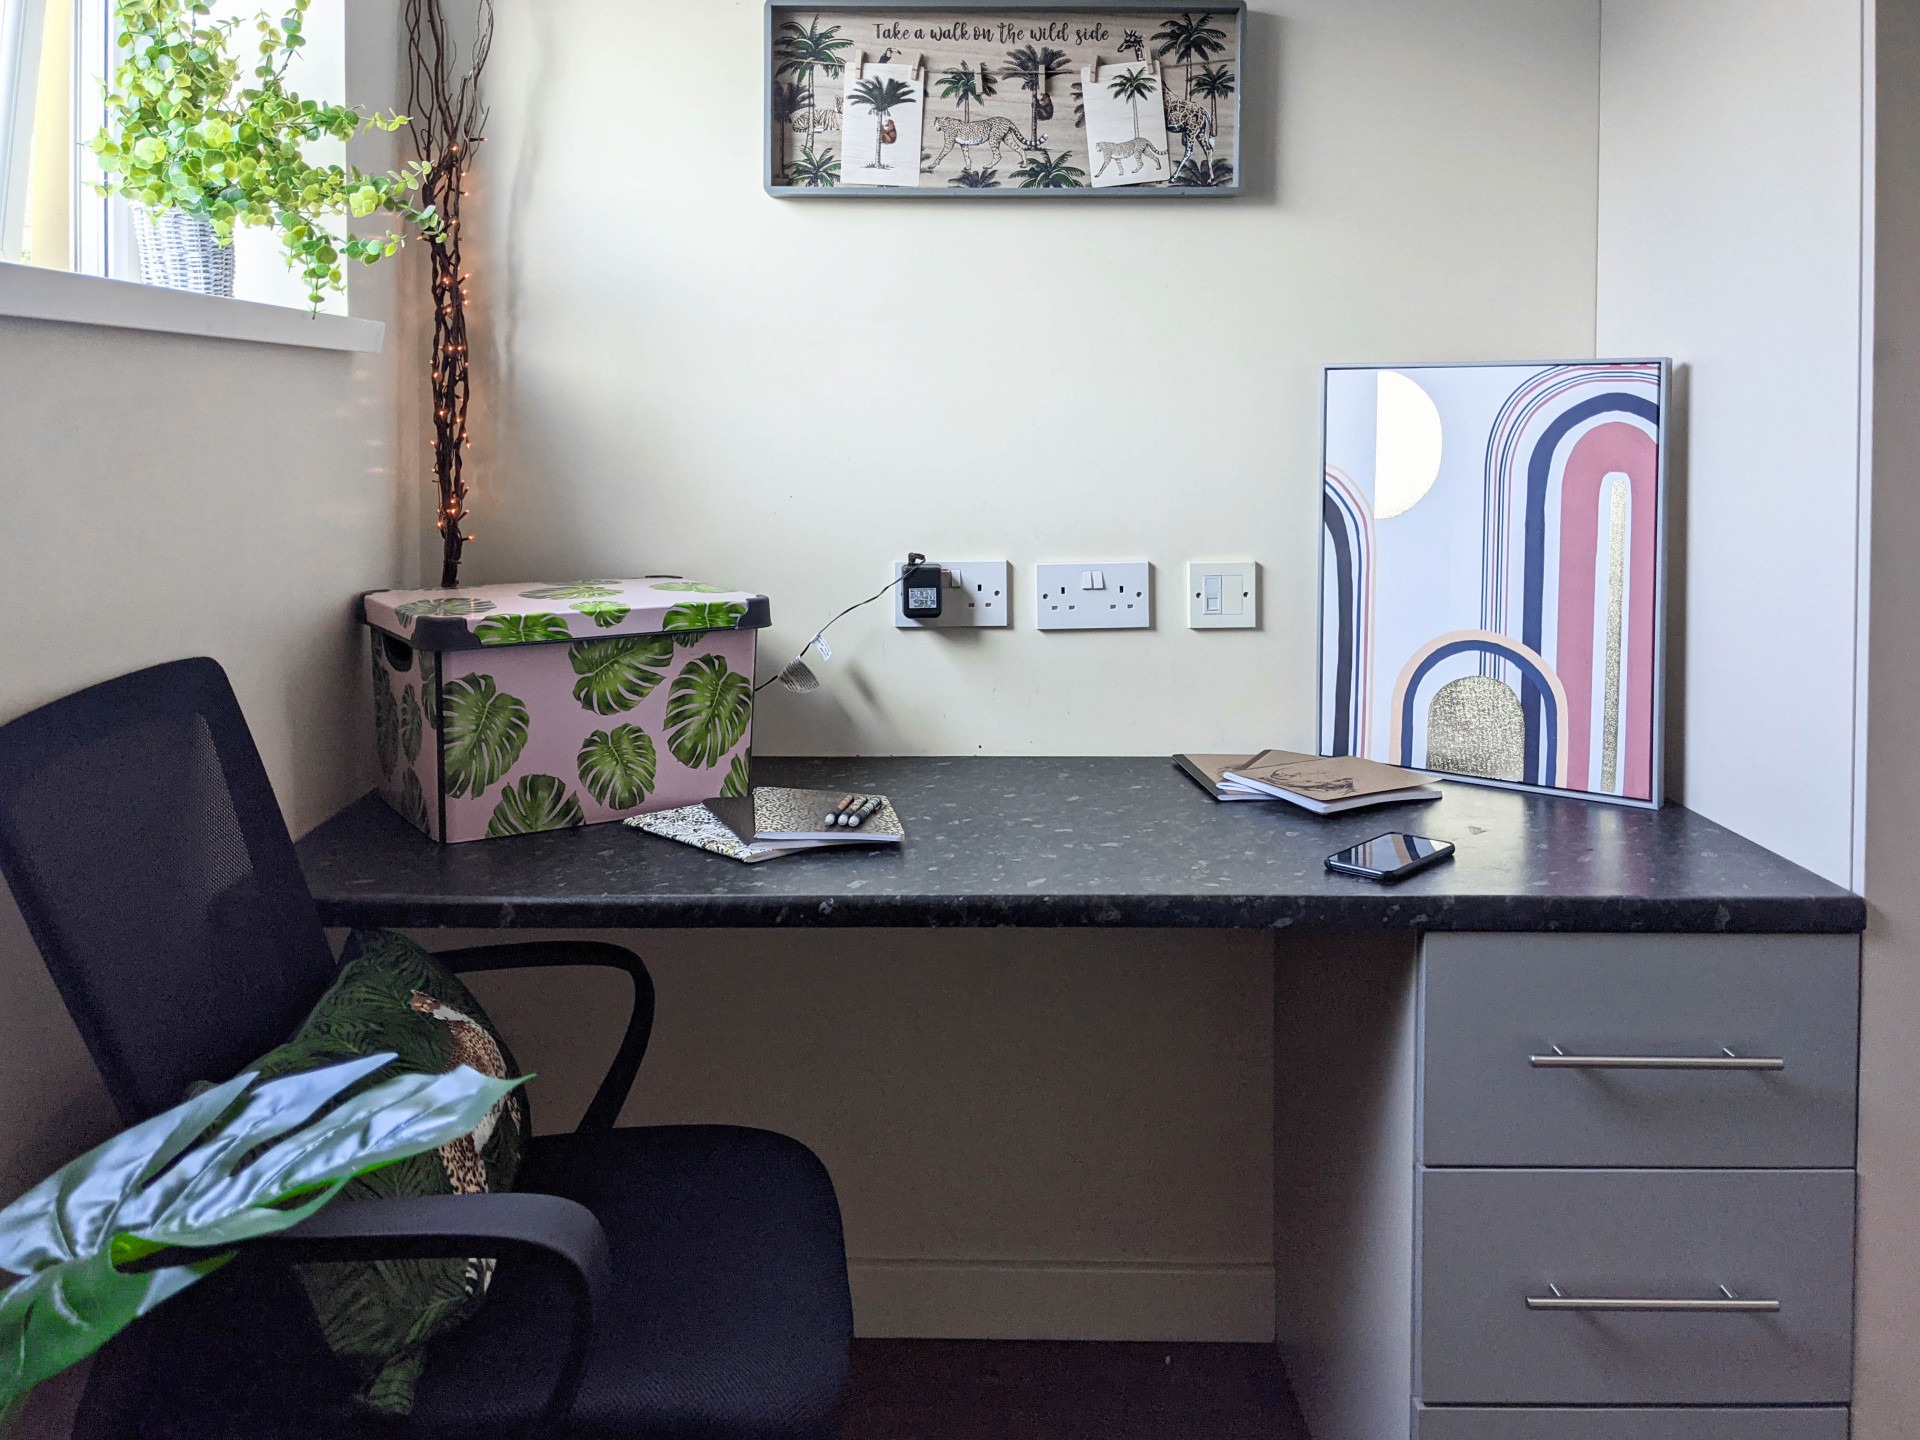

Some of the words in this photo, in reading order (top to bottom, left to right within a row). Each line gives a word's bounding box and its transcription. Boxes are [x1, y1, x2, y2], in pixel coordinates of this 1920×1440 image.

[872, 22, 910, 41] Take
[914, 28, 925, 41] a
[930, 22, 970, 42] walk
[973, 25, 995, 42] on
[997, 22, 1025, 44] the
[1030, 22, 1069, 42] wild
[1075, 22, 1109, 45] side
